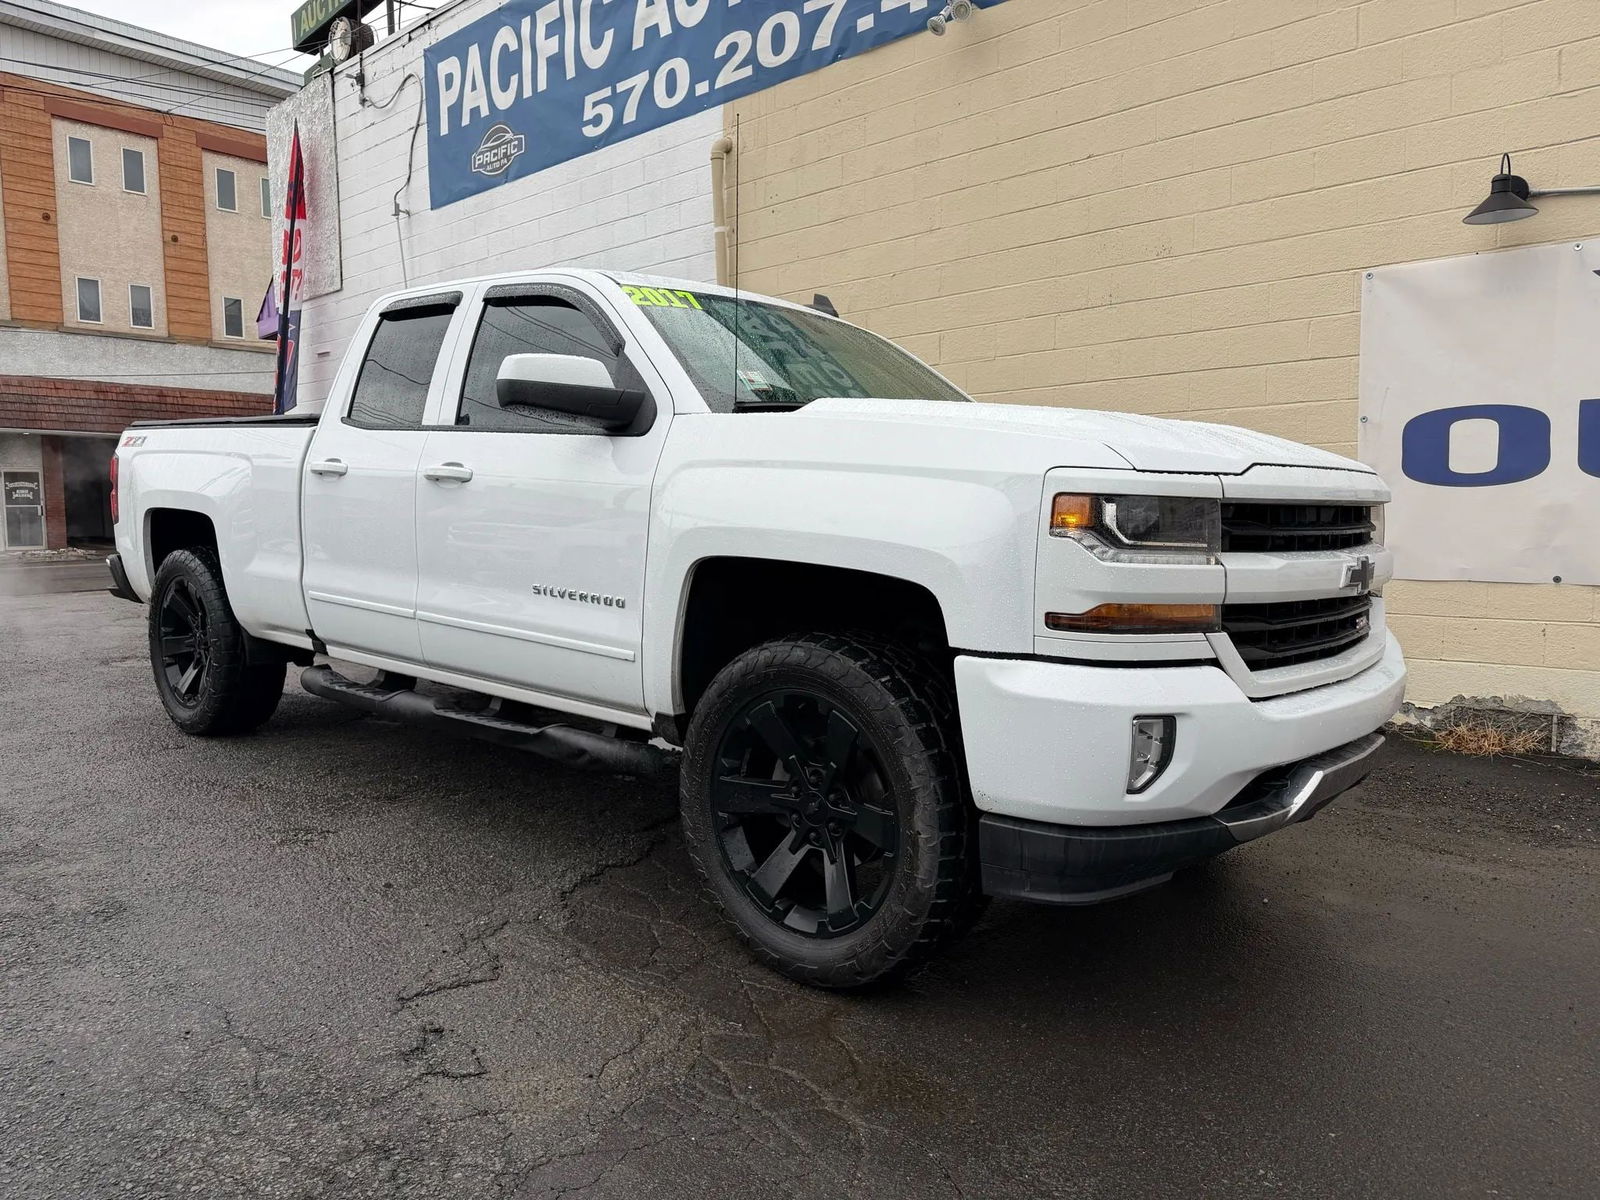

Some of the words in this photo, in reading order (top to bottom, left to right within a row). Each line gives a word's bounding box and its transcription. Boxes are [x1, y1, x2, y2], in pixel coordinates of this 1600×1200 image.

[437, 0, 615, 136] PACIFIC
[475, 141, 518, 168] PACIFIC
[621, 285, 703, 310] 2017
[122, 436, 147, 447] Z71
[532, 583, 626, 609] SILVERADO
